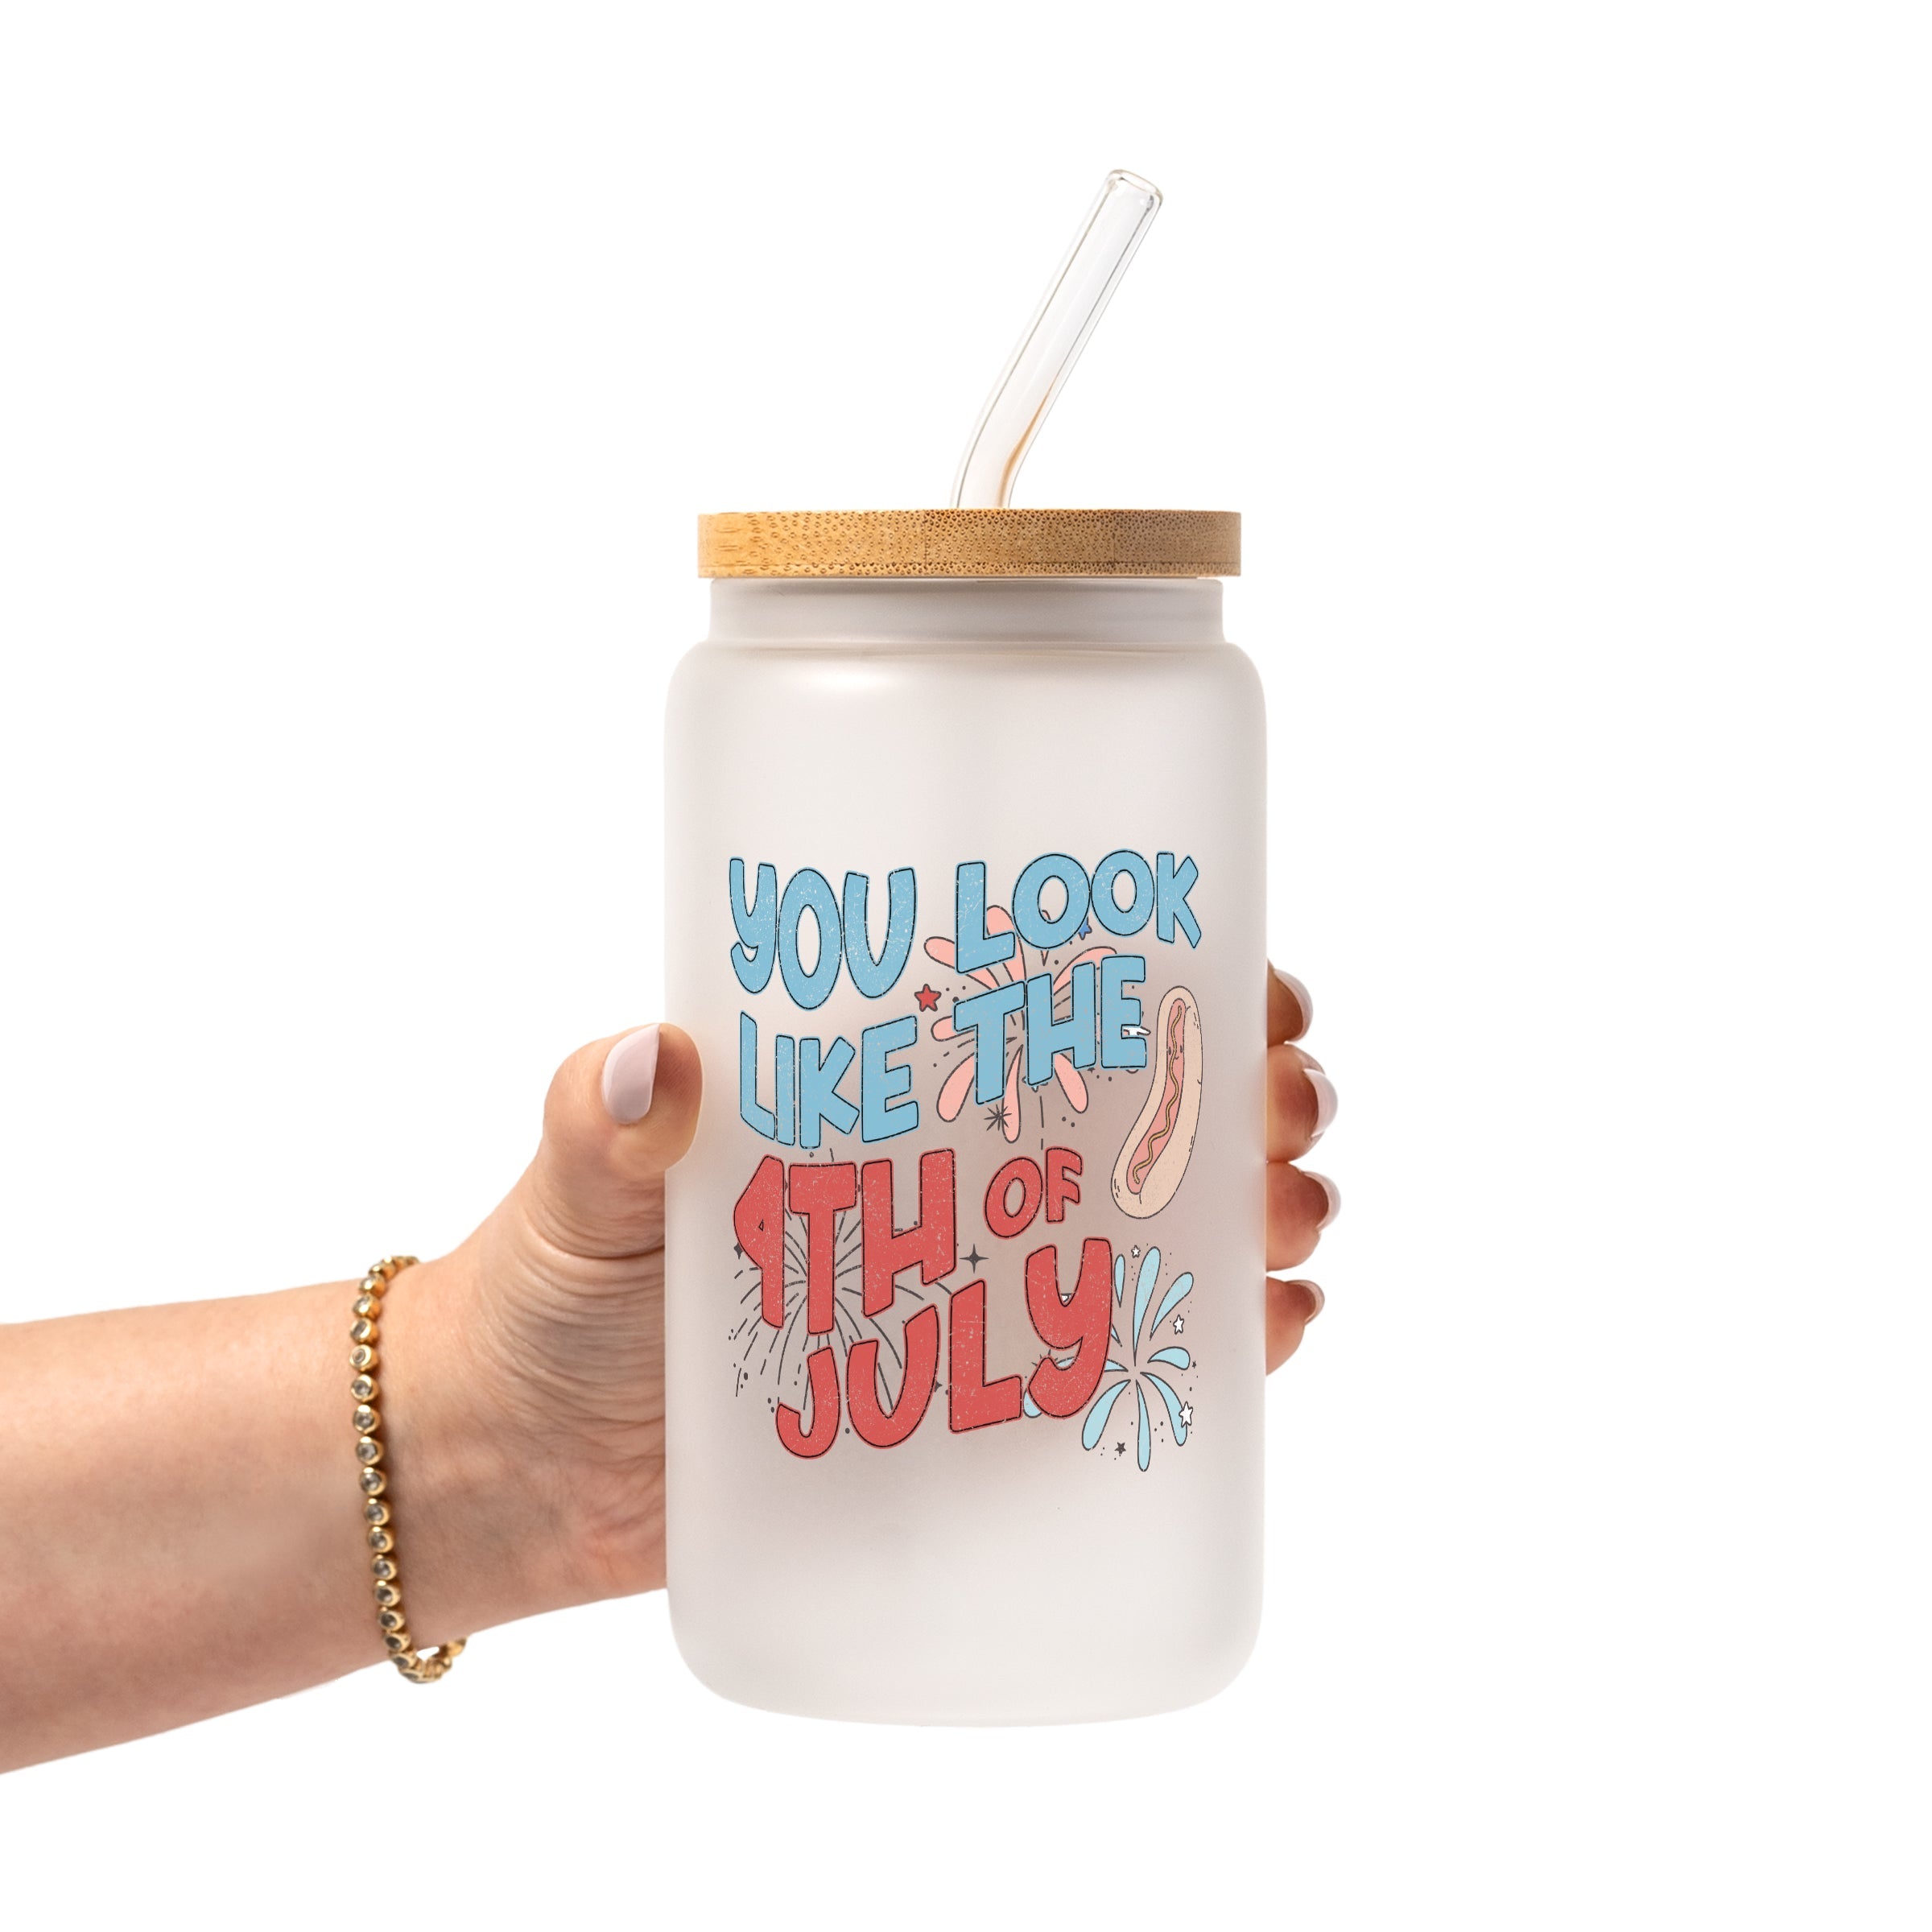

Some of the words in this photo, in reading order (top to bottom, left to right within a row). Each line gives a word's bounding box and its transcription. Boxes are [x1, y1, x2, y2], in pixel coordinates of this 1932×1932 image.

[729, 857, 918, 1010] YOU
[955, 848, 1202, 974] LOOK
[739, 1010, 920, 1150] LIKE
[953, 955, 1147, 1105] THE
[733, 1147, 958, 1336] 4TH
[984, 1146, 1084, 1238] OF
[775, 1237, 1113, 1459] JULY
